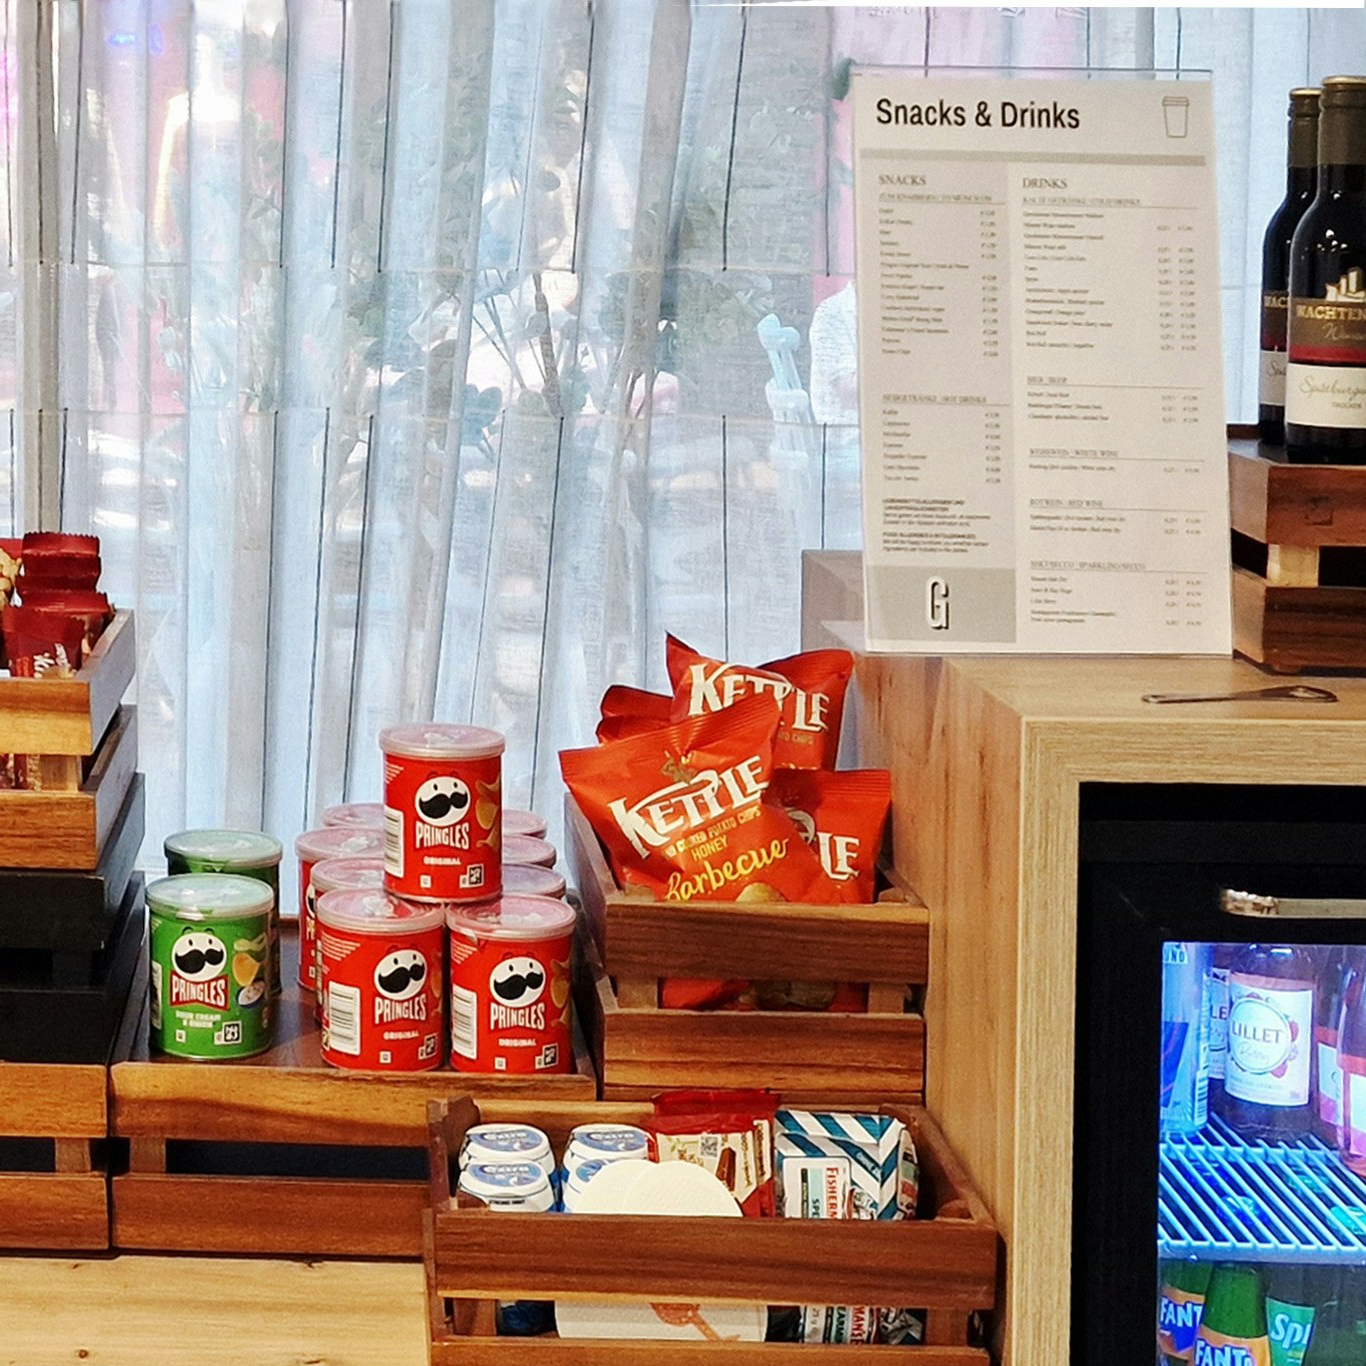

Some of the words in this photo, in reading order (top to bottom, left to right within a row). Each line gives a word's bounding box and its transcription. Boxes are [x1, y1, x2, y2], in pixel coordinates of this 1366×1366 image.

[876, 98, 966, 127] Snacks
[975, 102, 992, 127] &
[1001, 102, 1081, 130] Drinks
[878, 174, 926, 186] SNACKS
[1022, 178, 1068, 189] DRINKS
[607, 755, 771, 860] KETTLE
[416, 820, 470, 850] PRINGLES
[691, 834, 728, 861] HONEY
[666, 838, 790, 901] Barbecue
[172, 974, 226, 1007] PRINGLES
[374, 993, 427, 1025] PRINGLES
[490, 1002, 545, 1031] PRINGLES
[1160, 1297, 1204, 1328] FANT
